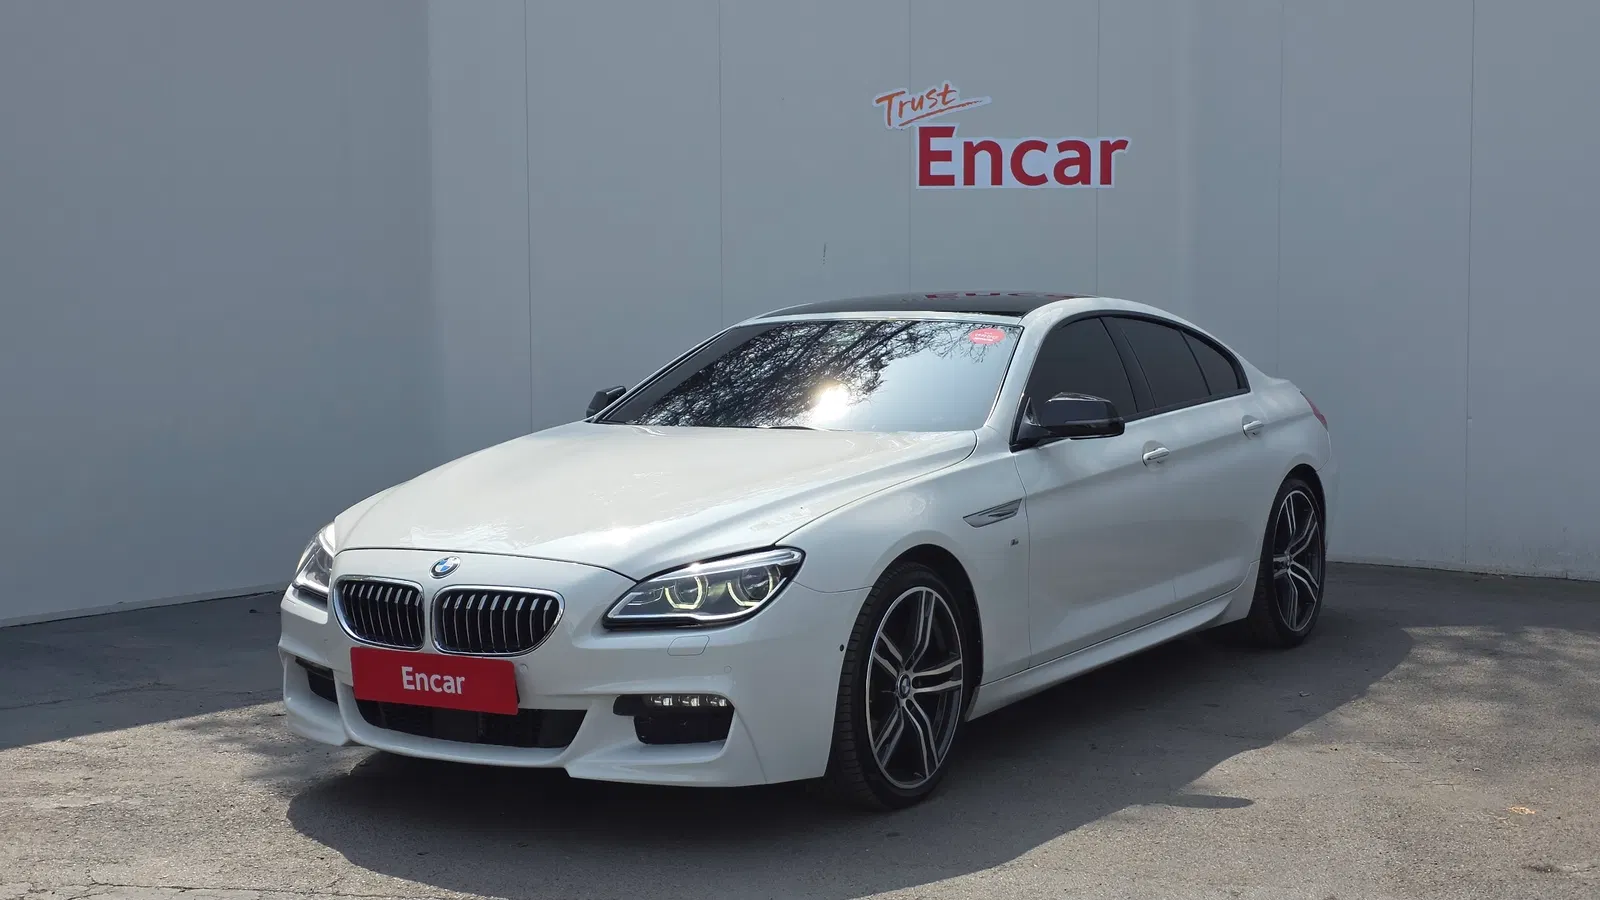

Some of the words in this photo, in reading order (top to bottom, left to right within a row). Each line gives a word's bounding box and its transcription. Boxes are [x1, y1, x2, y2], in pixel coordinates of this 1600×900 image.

[875, 83, 958, 127] Trust
[918, 126, 1129, 186] Encar
[401, 666, 465, 694] Encar
